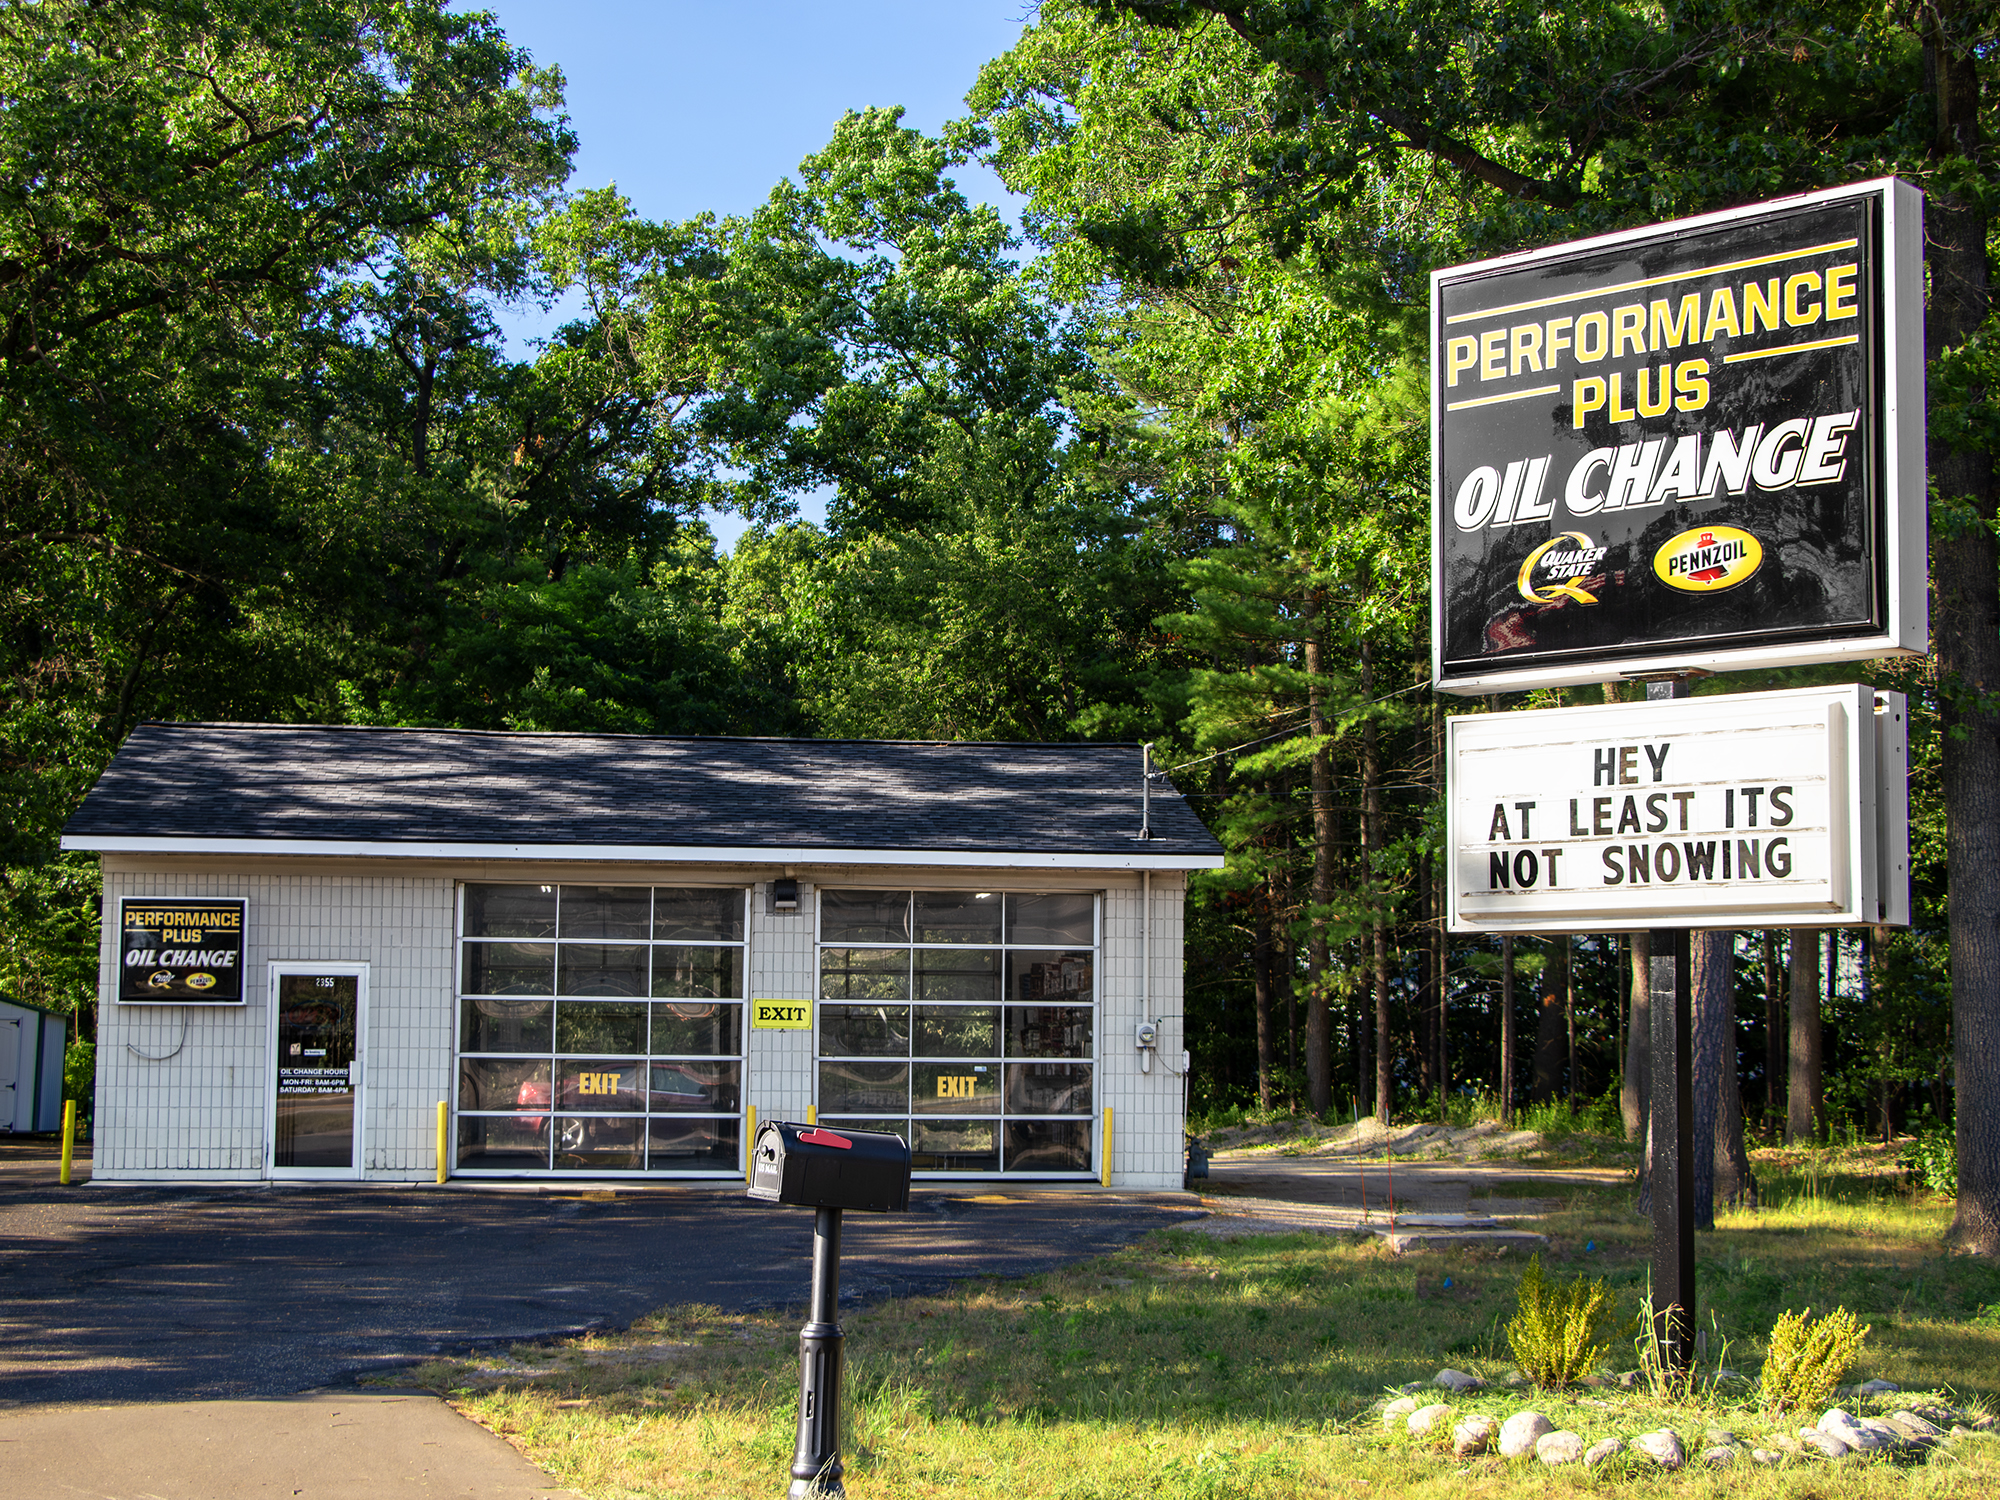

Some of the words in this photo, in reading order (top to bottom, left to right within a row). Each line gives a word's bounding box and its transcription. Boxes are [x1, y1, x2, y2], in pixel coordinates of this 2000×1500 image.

[1447, 263, 1858, 387] PERFORMANCE
[1572, 358, 1710, 429] PLUS
[1453, 453, 1556, 533] OIL
[1565, 408, 1860, 517] CHANGE
[1540, 547, 1607, 568] QUAKER
[1668, 539, 1748, 576] PENNZOIL
[1547, 562, 1595, 579] STATE
[1593, 743, 1670, 786] HEY
[1489, 801, 1536, 840] AT
[1570, 791, 1695, 836] LEAST
[1725, 785, 1793, 828] ITS
[1489, 848, 1563, 889] NOT
[1603, 836, 1792, 885] SNOWING
[125, 911, 240, 927] PERFORMANCE
[162, 928, 202, 943] PLUS
[125, 949, 157, 967] OIL
[159, 949, 238, 967] CHANGE
[316, 977, 334, 987] 2355
[758, 1006, 806, 1022] EXIT
[579, 1072, 621, 1095] EXIT
[937, 1076, 978, 1098] EXIT
[758, 1162, 765, 1172] US
[765, 1163, 778, 1174] MAIL
